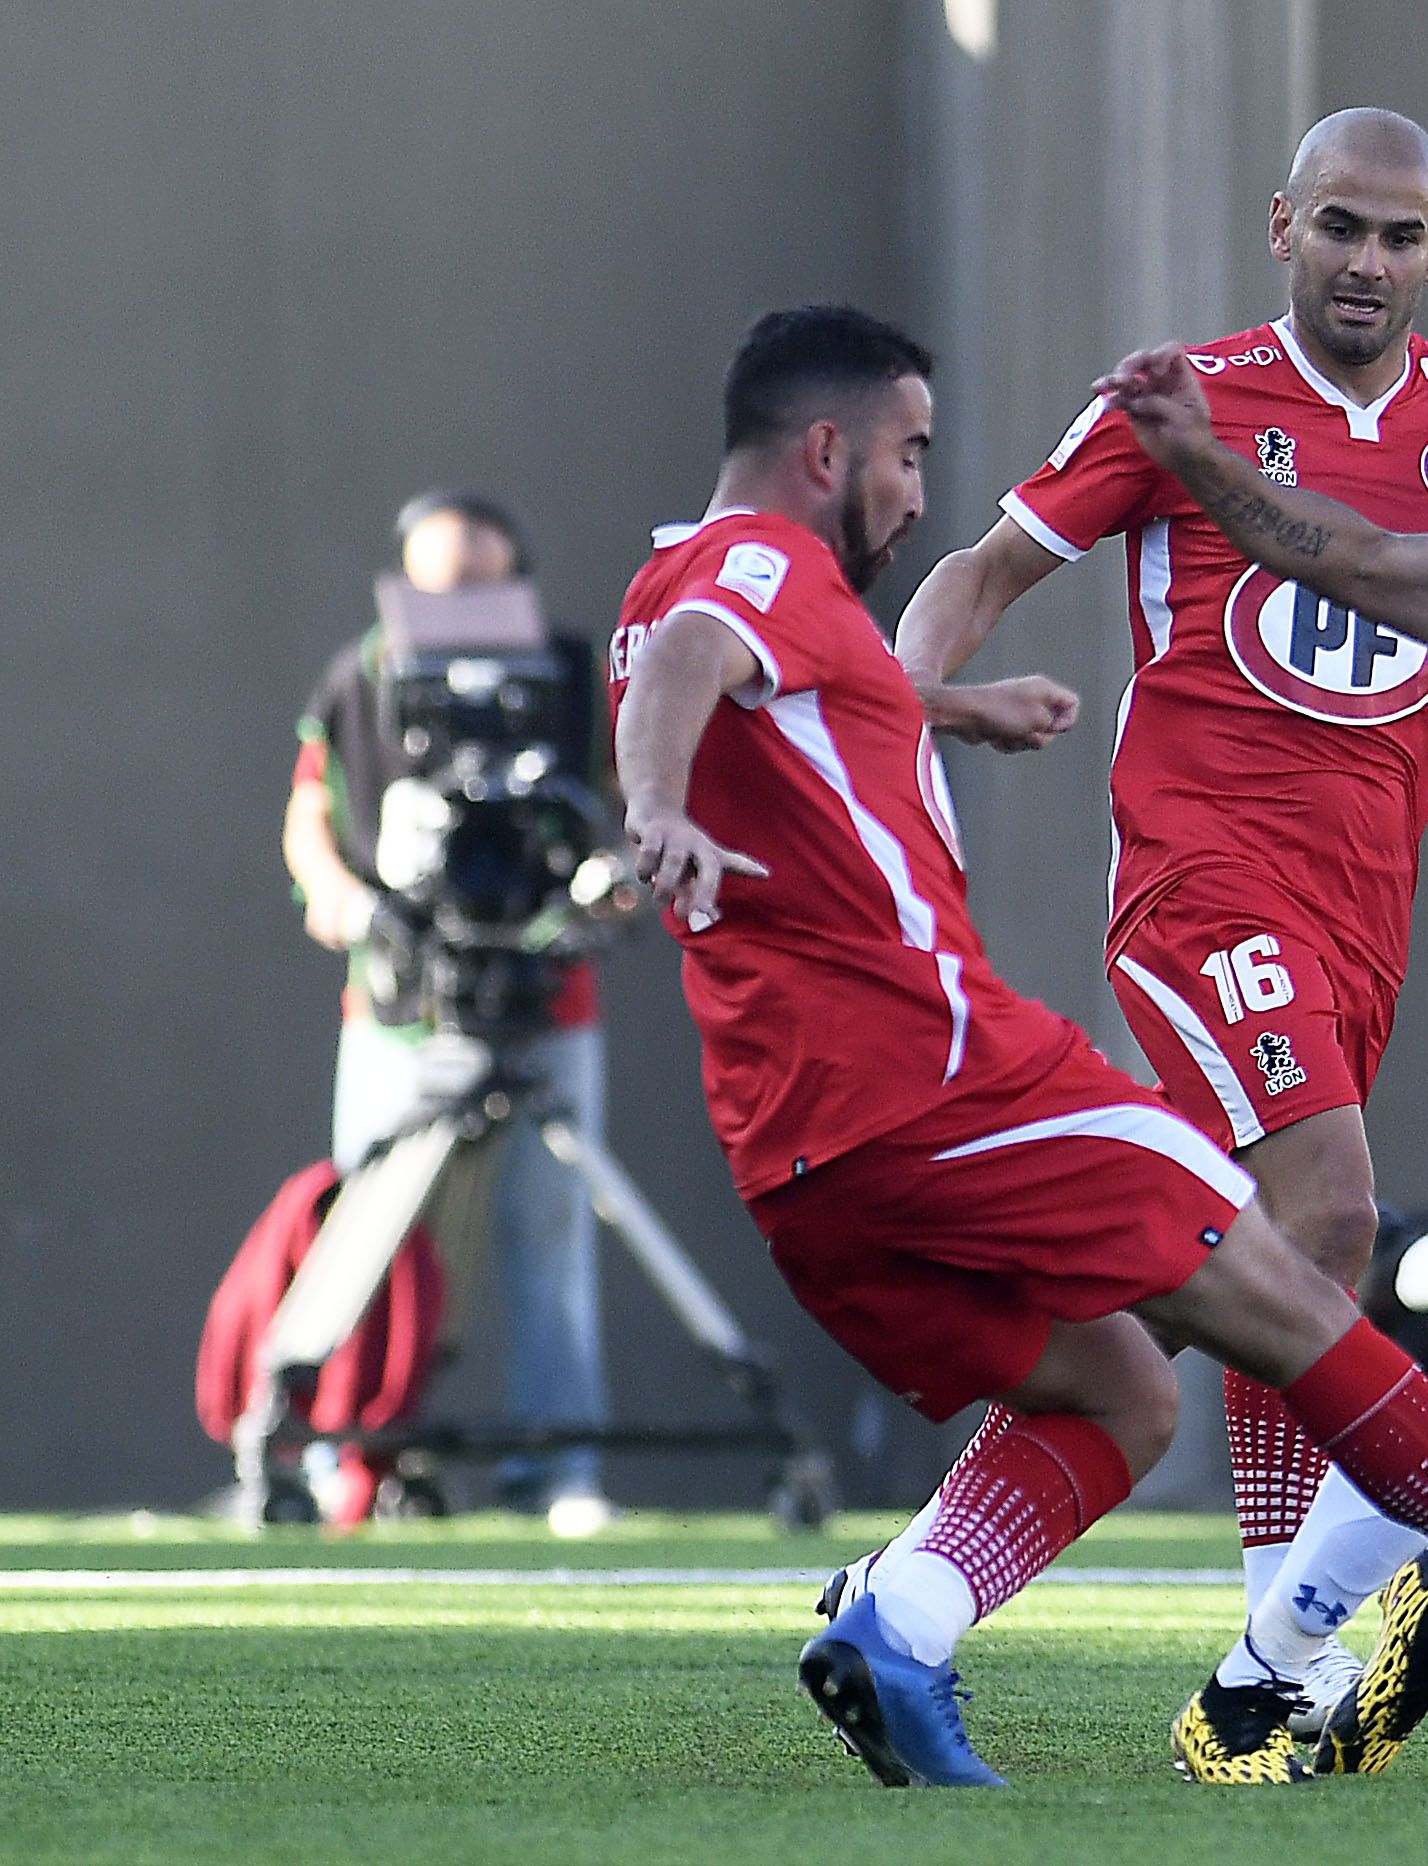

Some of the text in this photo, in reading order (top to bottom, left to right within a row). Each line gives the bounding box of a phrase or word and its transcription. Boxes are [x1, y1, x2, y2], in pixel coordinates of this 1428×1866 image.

[1259, 470, 1296, 485] YON
[1288, 580, 1398, 687] PF
[1200, 933, 1295, 1025] 16
[1267, 1069, 1303, 1093] LYON
